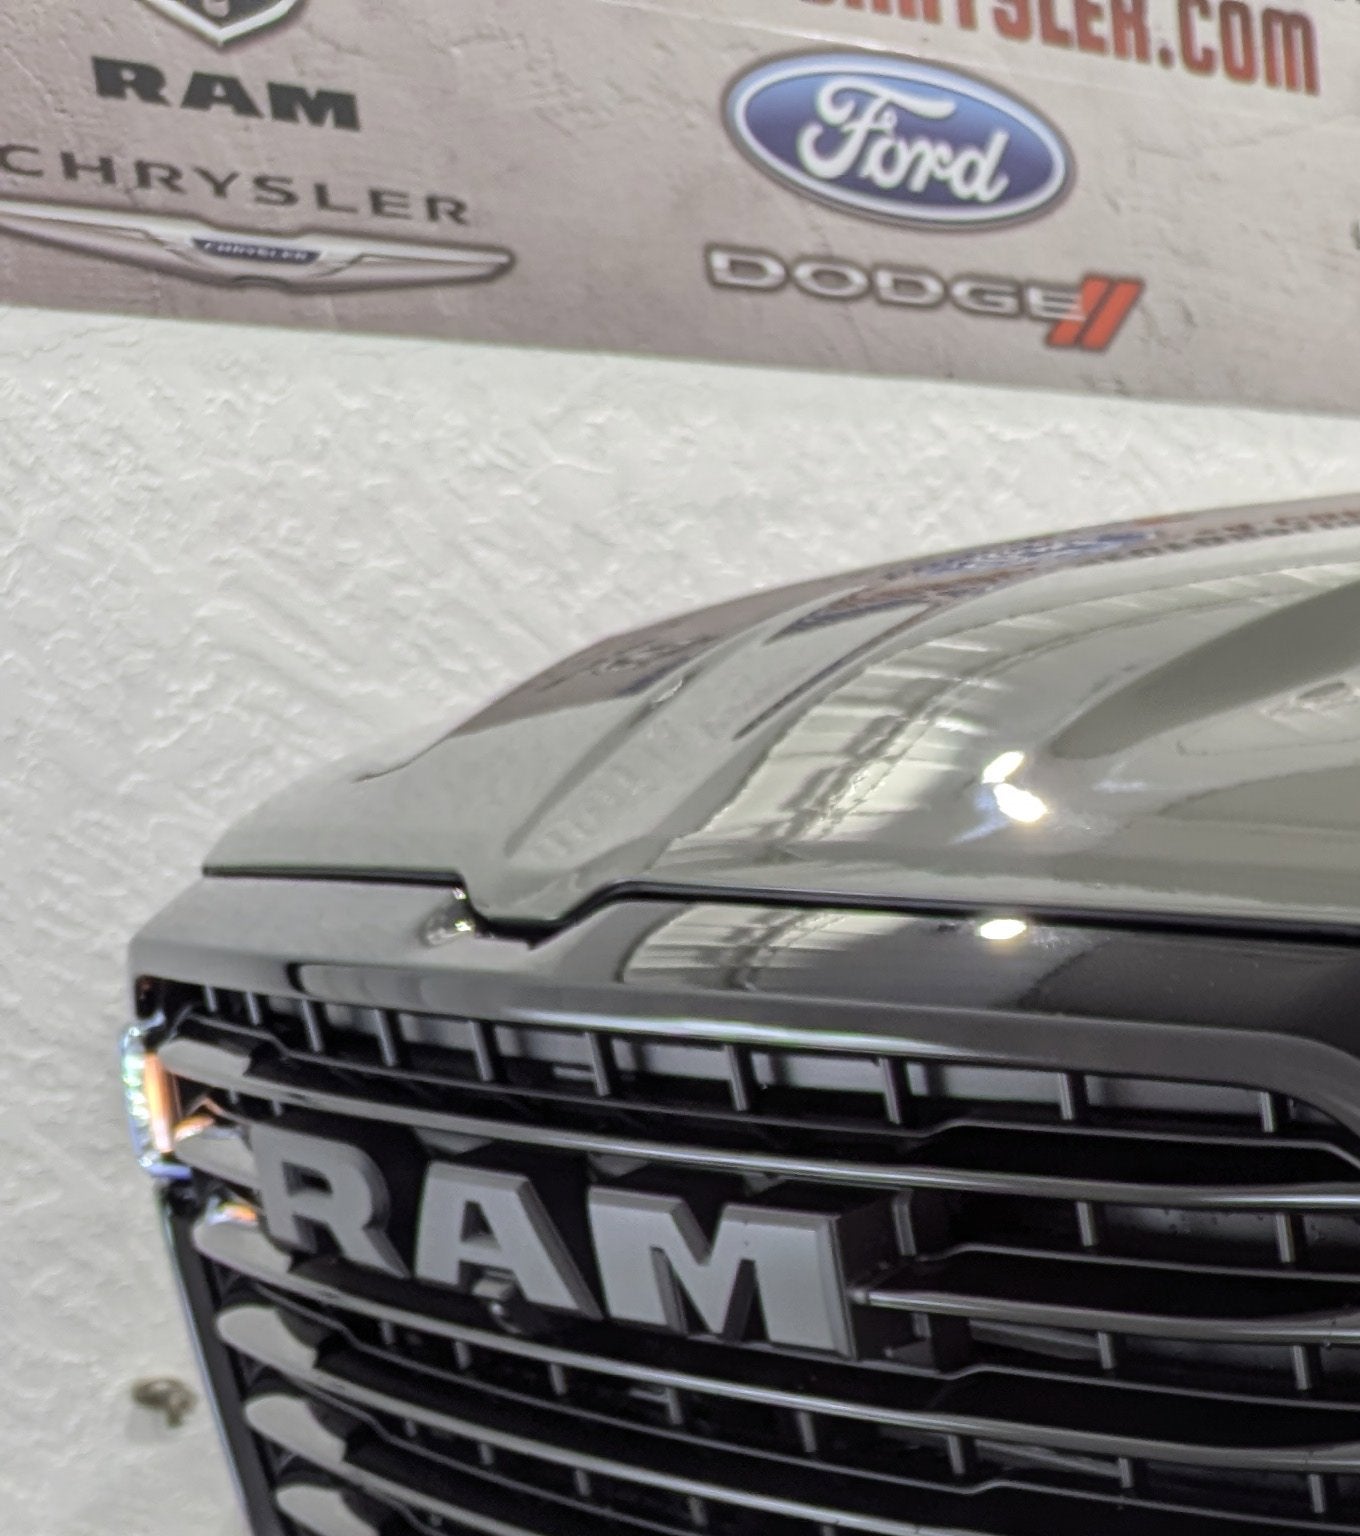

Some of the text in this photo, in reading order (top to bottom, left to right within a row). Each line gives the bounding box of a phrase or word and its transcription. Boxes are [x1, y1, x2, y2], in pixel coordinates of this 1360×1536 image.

[92, 58, 361, 131] RAM
[799, 78, 1008, 202] Ford
[0, 143, 470, 226] CHRYSLER
[704, 246, 1092, 322] DODGE
[246, 1124, 858, 1360] RAM
